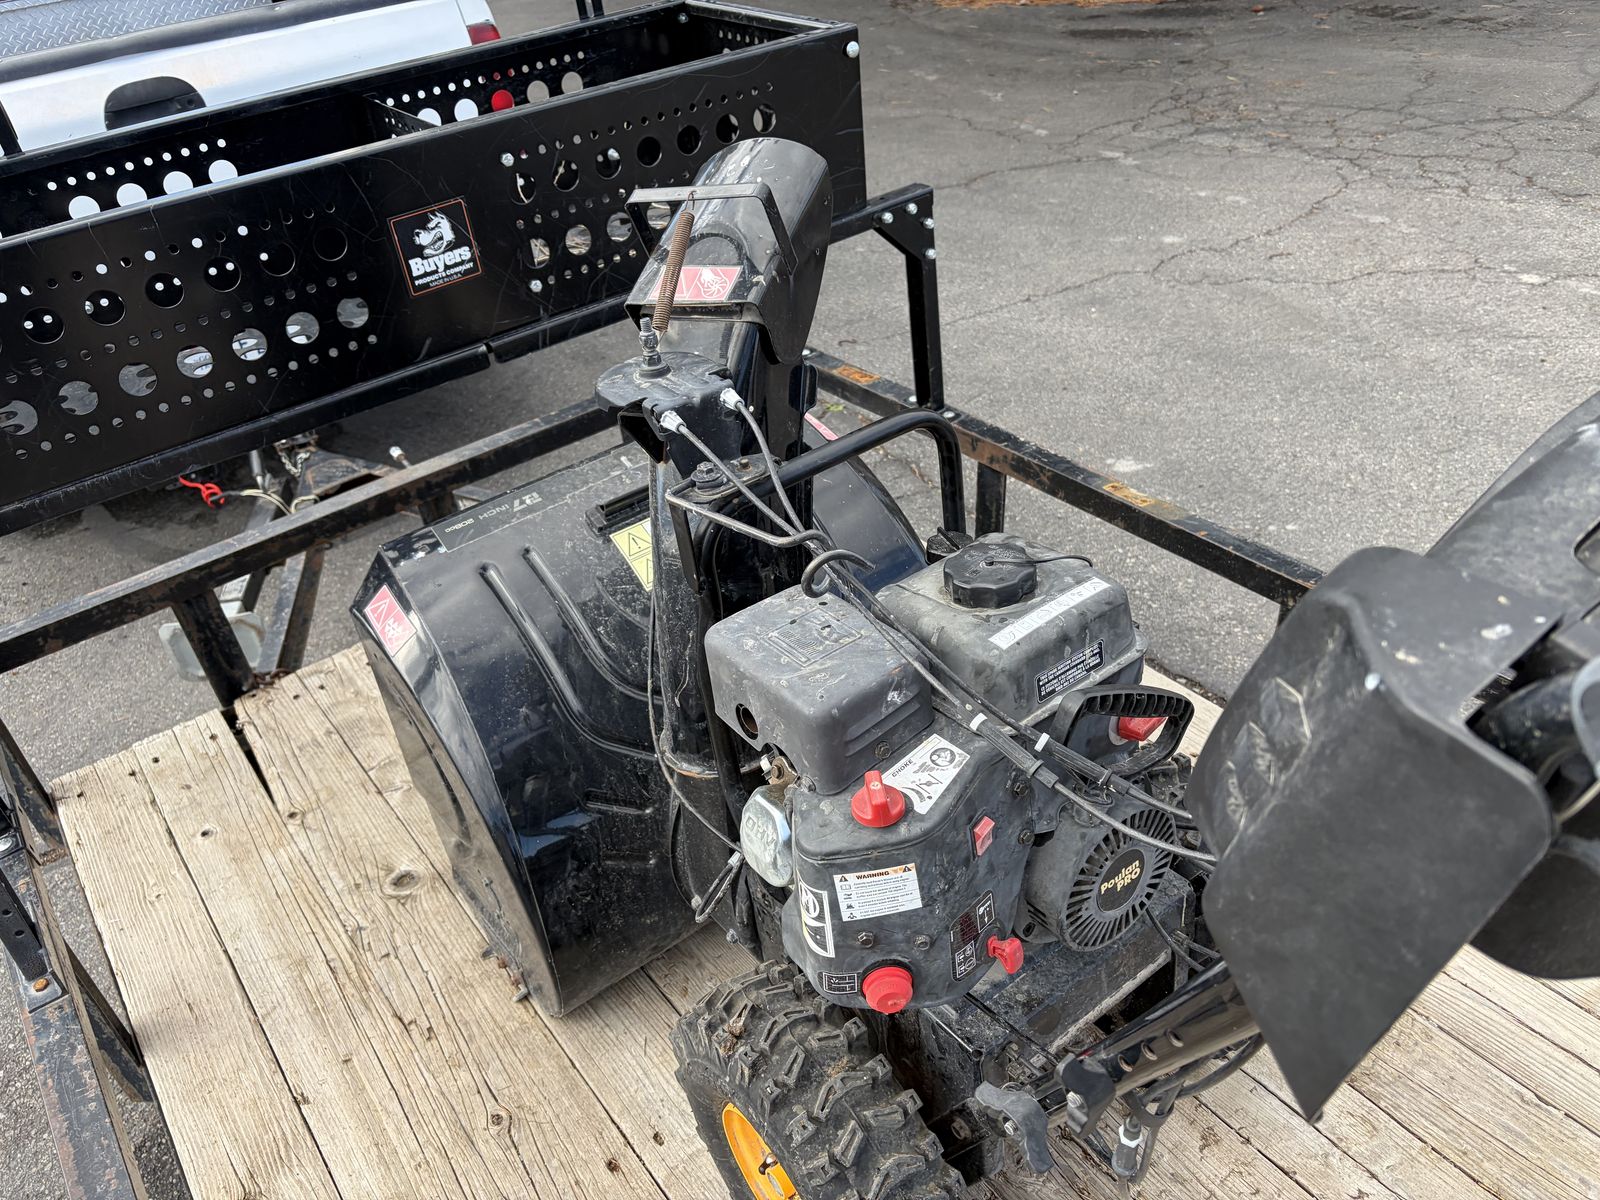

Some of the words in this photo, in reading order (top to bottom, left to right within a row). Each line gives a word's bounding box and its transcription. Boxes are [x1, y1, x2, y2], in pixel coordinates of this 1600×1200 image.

[408, 246, 472, 277] Buyers
[414, 271, 446, 286] PRODUCTS
[446, 262, 474, 275] COMPANY
[478, 503, 510, 520] INCH
[512, 491, 544, 512] 27
[444, 517, 475, 533] 208cc
[891, 758, 914, 778] CHOKE
[855, 870, 890, 881] WARNING
[1116, 867, 1141, 892] PRO
